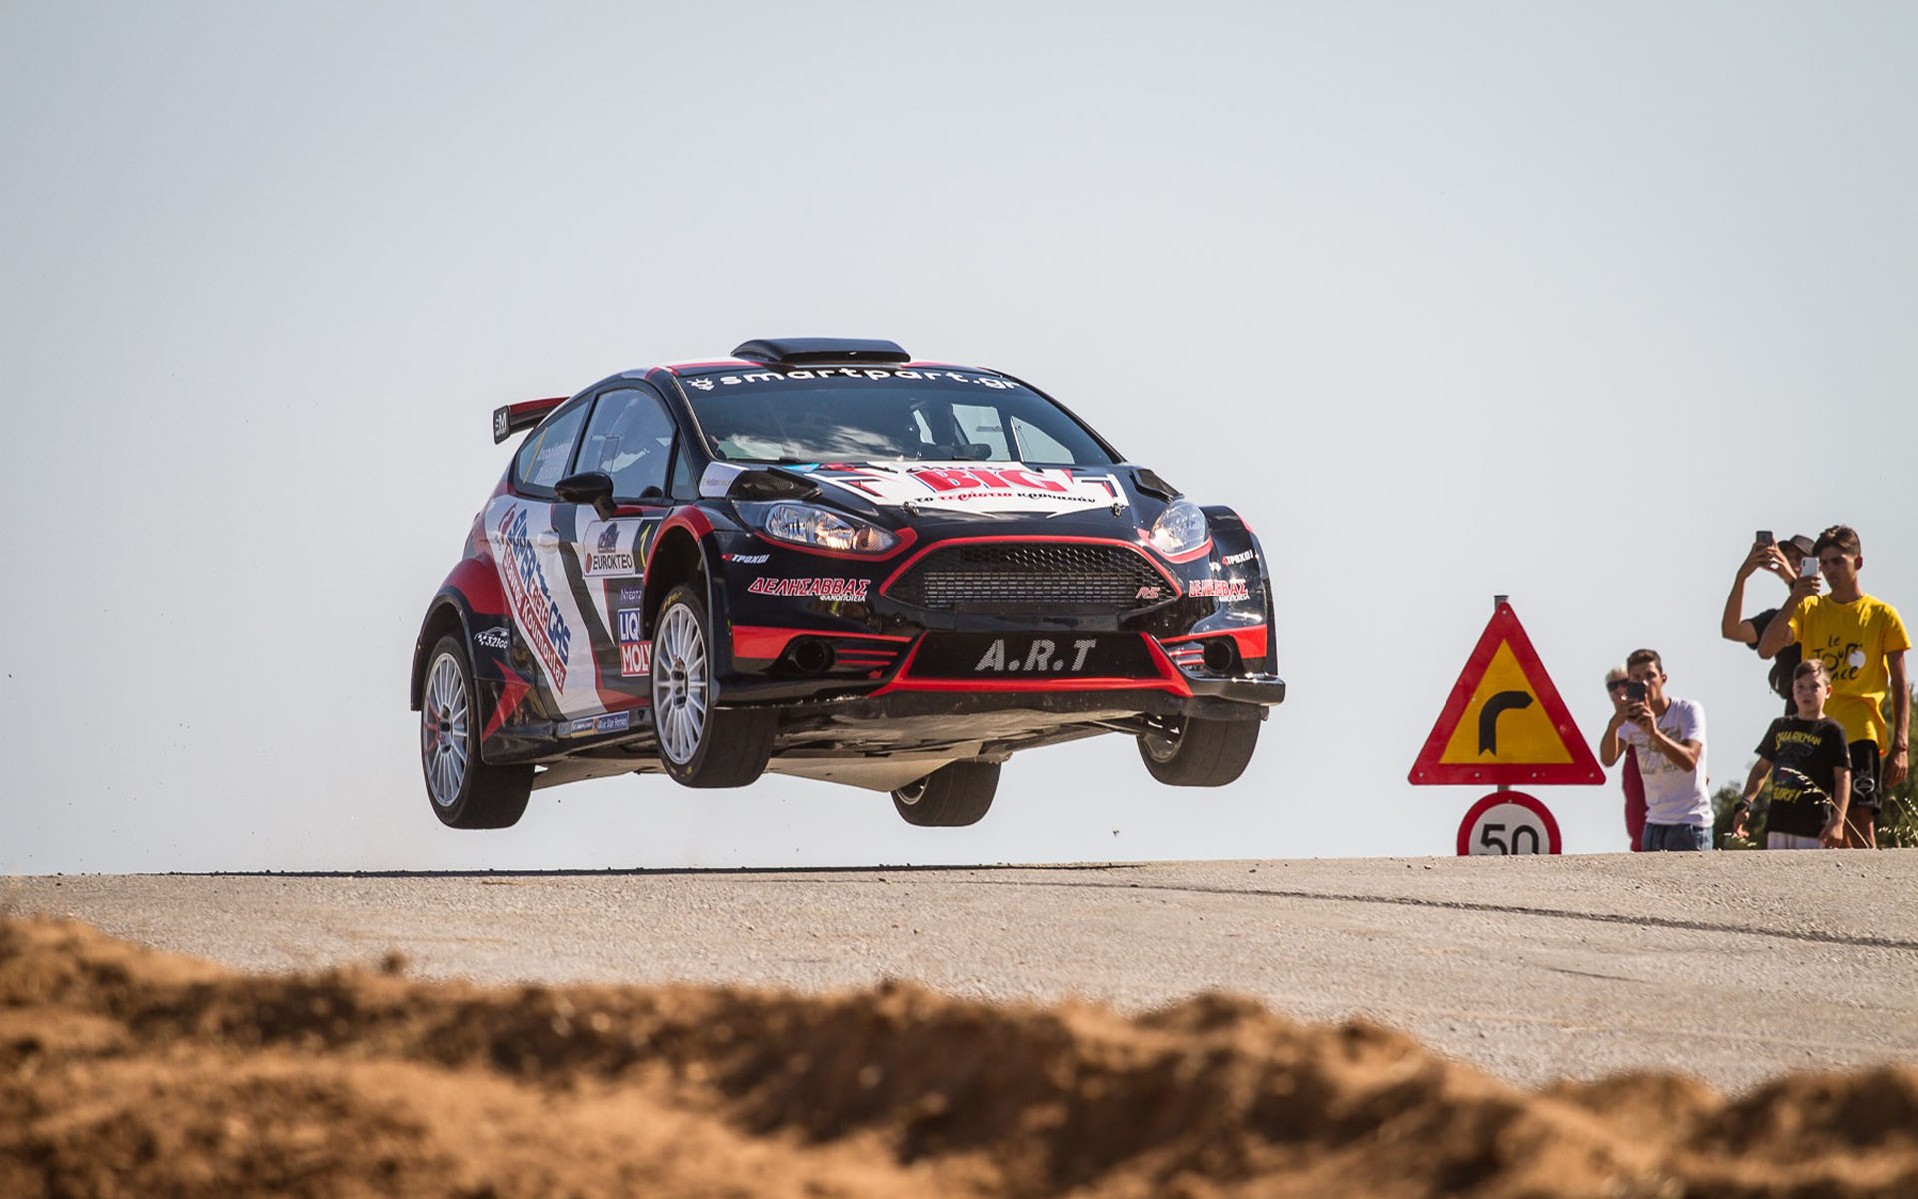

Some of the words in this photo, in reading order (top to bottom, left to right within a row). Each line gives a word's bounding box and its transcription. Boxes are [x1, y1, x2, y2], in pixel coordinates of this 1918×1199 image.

[720, 367, 1020, 389] smartpart.gr
[909, 470, 1068, 493] BIG
[593, 554, 633, 570] EUROKTEO
[748, 576, 872, 596] ΔΕΛΗΣΑΒΒΑΣ
[521, 596, 565, 687] Koumoulas
[621, 643, 652, 673] MOLY
[1481, 823, 1539, 854] 50
